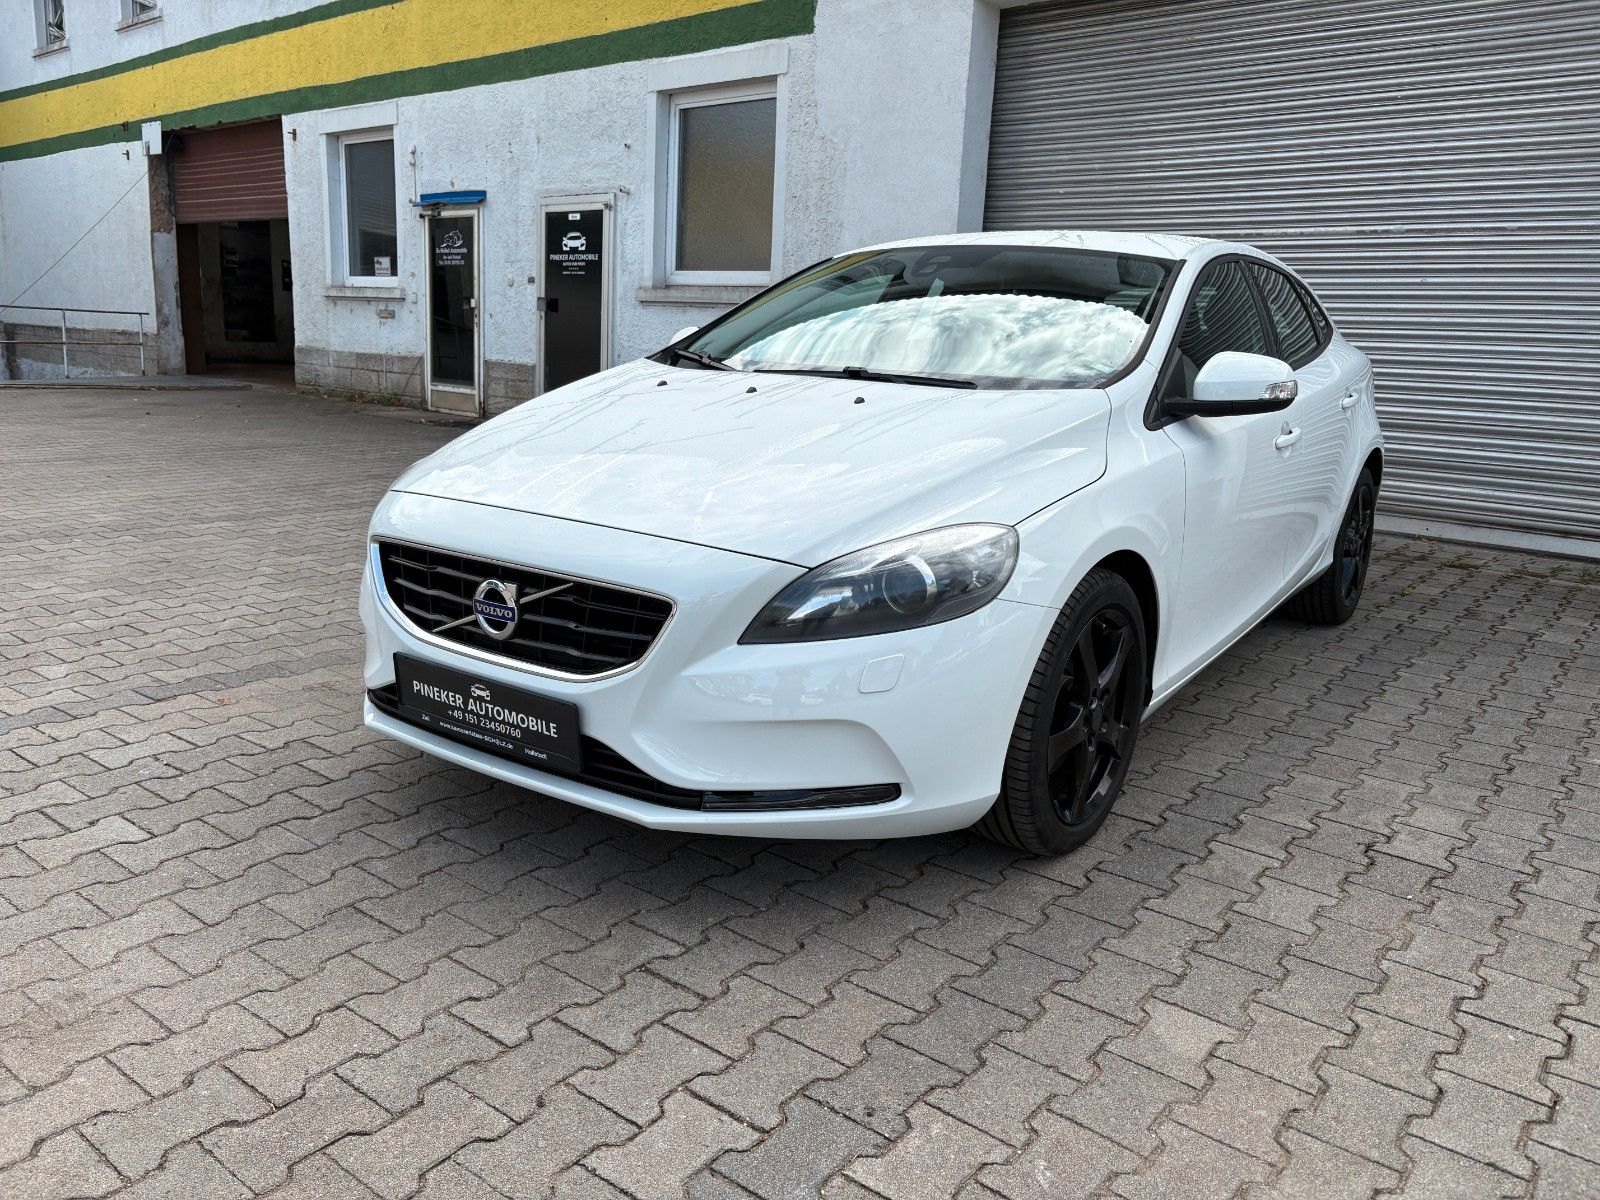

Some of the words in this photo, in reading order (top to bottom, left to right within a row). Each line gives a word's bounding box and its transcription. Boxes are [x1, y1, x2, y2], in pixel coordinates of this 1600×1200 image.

[569, 253, 600, 261] AUTOMOBILE
[475, 602, 513, 618] VOLVO
[412, 680, 464, 710] PINEKER
[467, 698, 558, 738] AUTOMOBILE
[447, 708, 463, 720] +49
[464, 712, 478, 725] 151
[480, 718, 521, 739] 23450760
